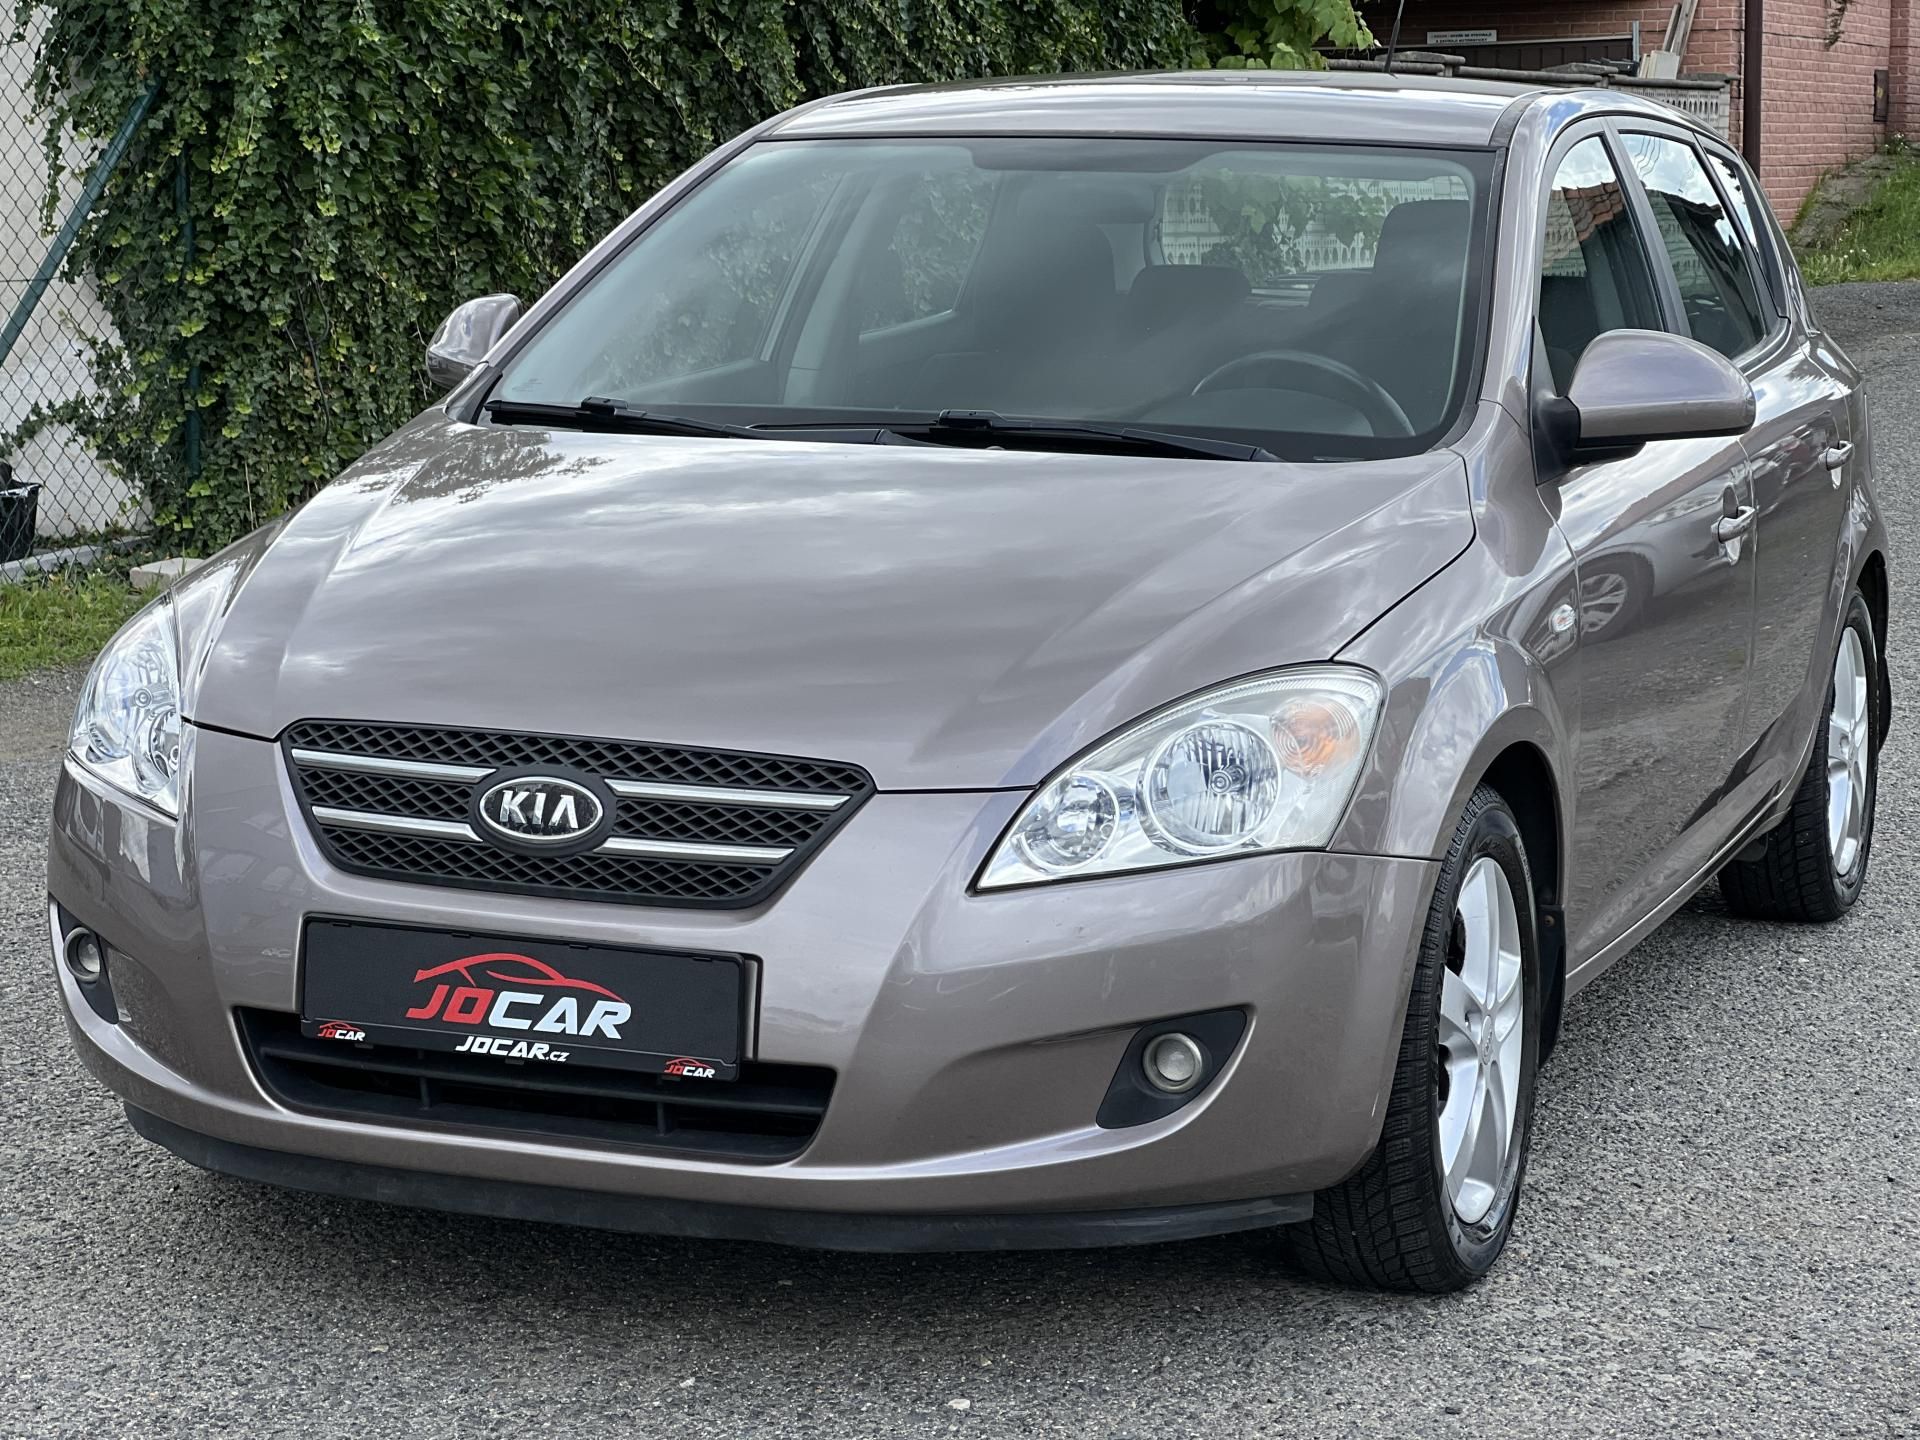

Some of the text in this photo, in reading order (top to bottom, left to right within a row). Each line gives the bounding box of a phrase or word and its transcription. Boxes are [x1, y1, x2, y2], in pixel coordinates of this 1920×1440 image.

[499, 789, 579, 829] KIA
[405, 984, 632, 1039] JOCAR
[317, 1028, 366, 1042] JOCAR
[663, 1064, 716, 1079] JOCAR
